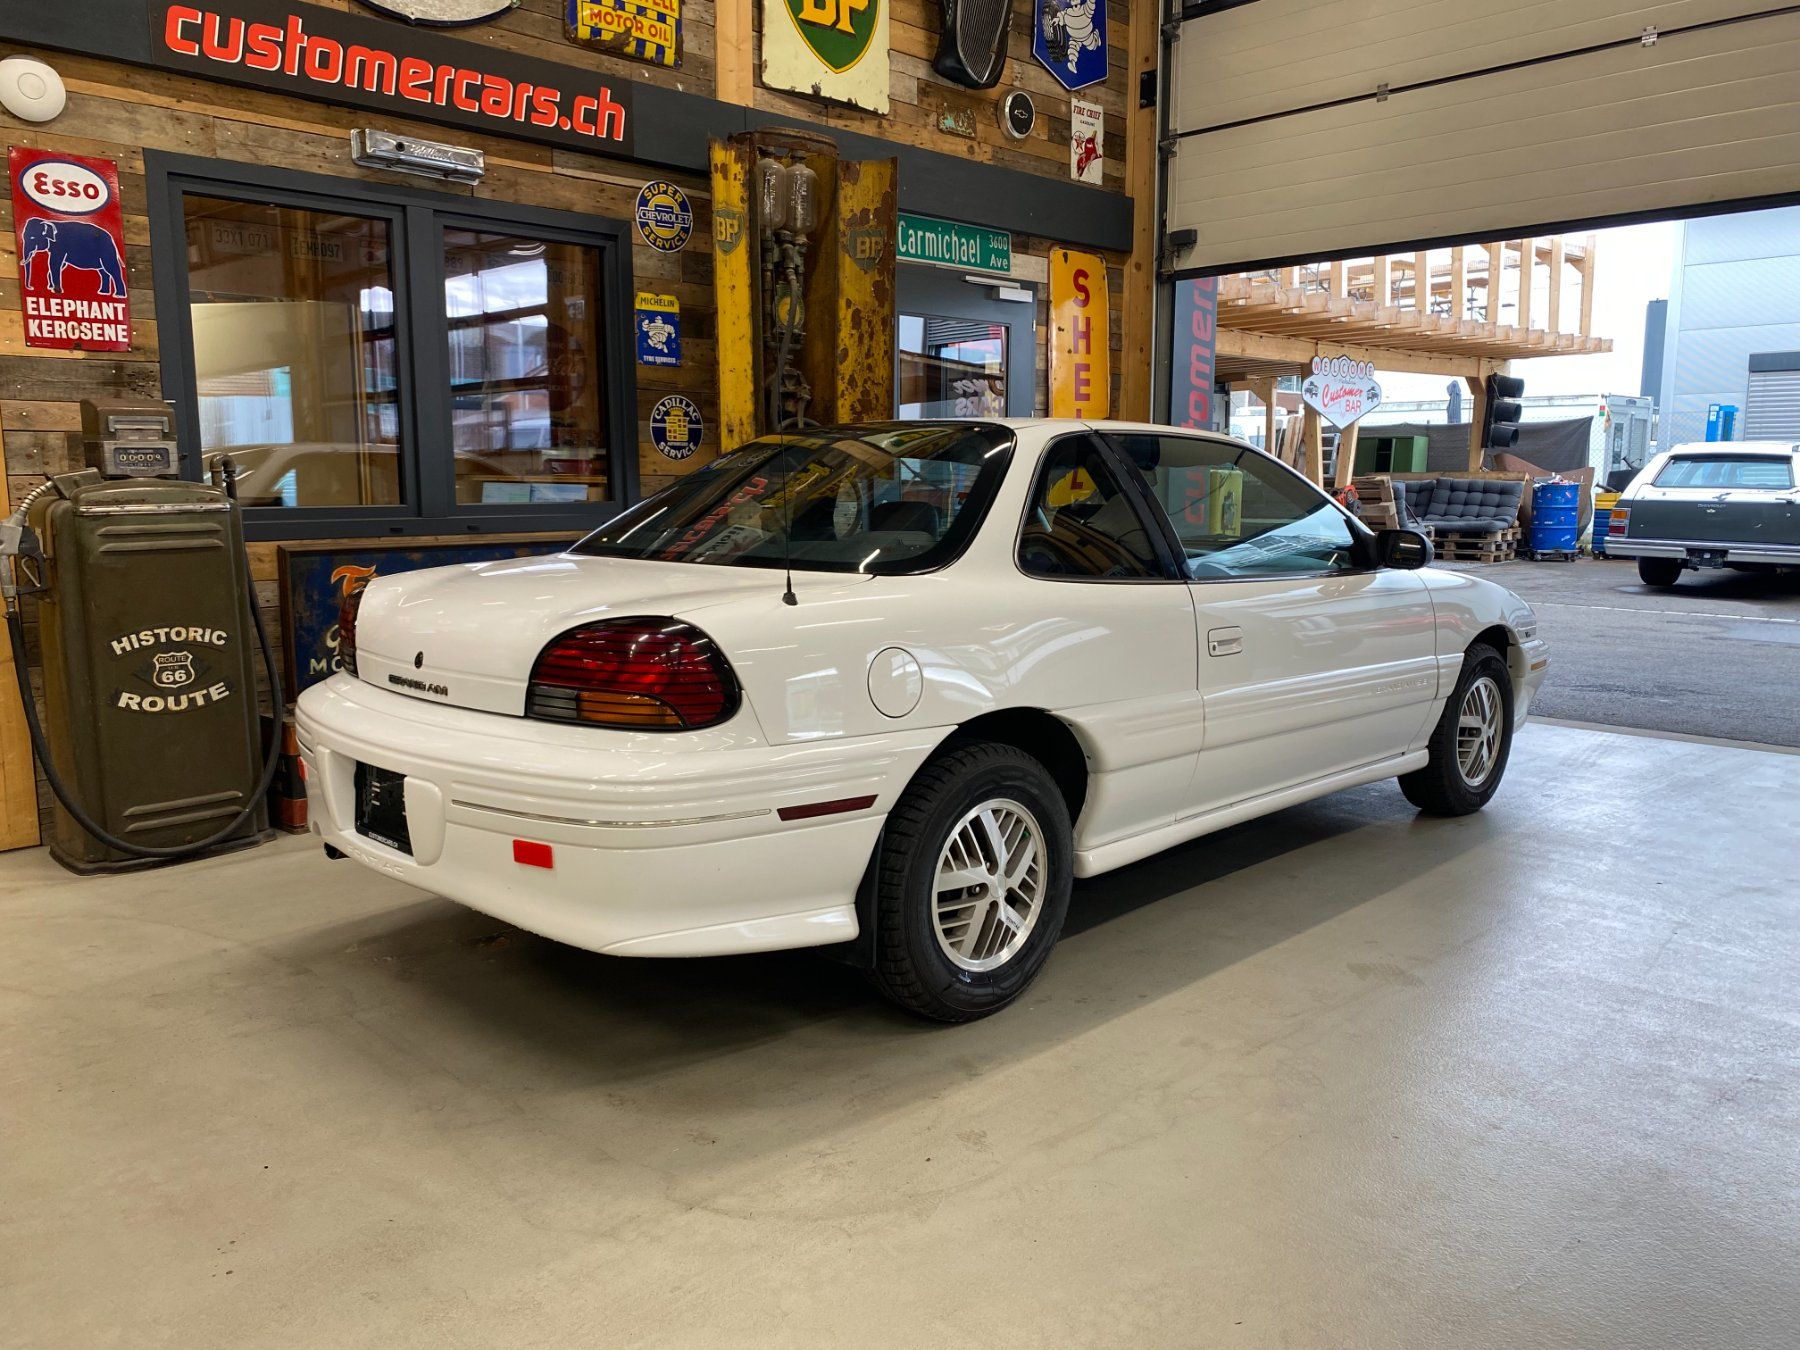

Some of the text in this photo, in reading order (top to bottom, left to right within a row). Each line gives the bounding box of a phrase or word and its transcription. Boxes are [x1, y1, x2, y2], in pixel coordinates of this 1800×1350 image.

[589, 7, 670, 43] MOTOR OIL
[165, 5, 625, 141] customercars.ch
[643, 183, 683, 203] SUPER
[640, 210, 690, 224] CHEVROLET
[643, 226, 687, 249] SERVICE
[716, 216, 739, 242] BP
[899, 221, 1008, 264] Carmichael 3600
[989, 253, 1008, 269] Ave
[26, 297, 126, 321] ELEPHANT
[640, 297, 674, 307] MICHELIN
[28, 319, 129, 342] KEROSENE
[1313, 361, 1374, 375] WELCOME
[655, 398, 699, 420] CADILLAC
[1345, 400, 1362, 412] BAR
[659, 442, 696, 459] SERVICE
[111, 626, 228, 655] HISTORIC
[158, 655, 186, 663] ROUTE
[161, 669, 187, 682] 66
[117, 681, 230, 712] ROUTE
